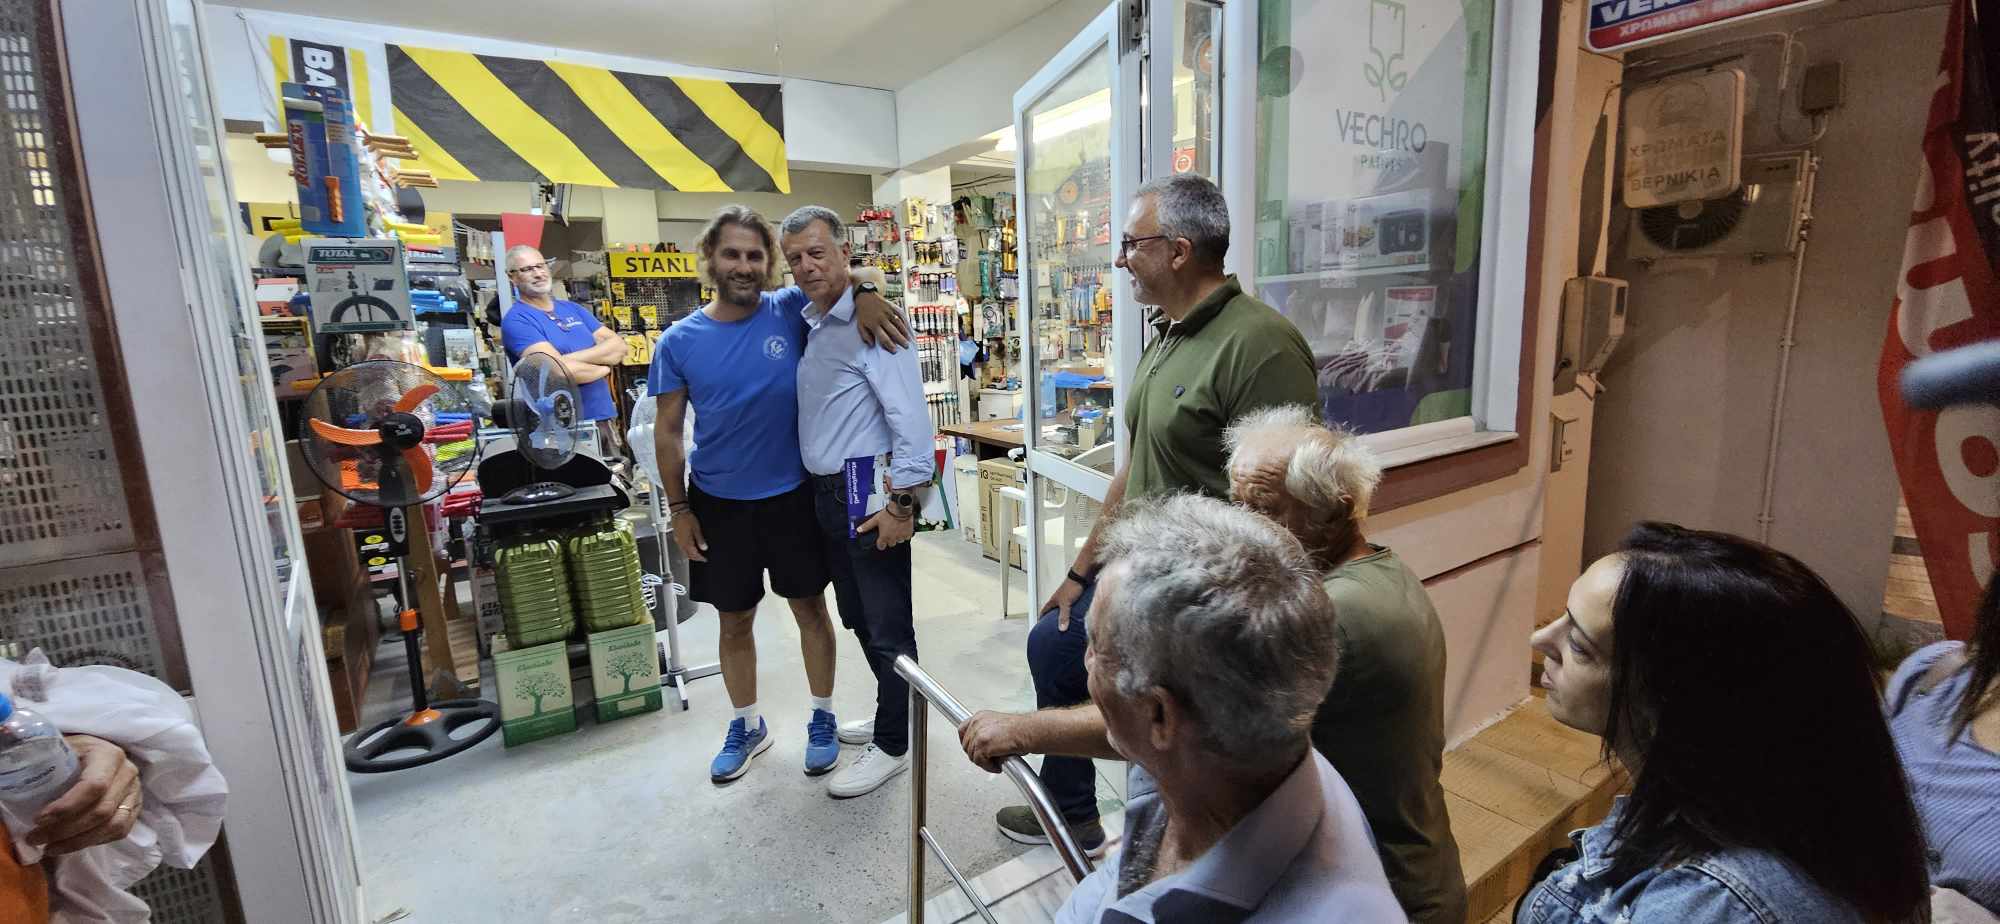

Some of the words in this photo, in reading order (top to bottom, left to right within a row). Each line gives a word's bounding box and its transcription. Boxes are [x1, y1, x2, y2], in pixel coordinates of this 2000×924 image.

[302, 46, 337, 88] BA
[1335, 108, 1427, 153] VECHRO
[1630, 166, 1721, 191] ΒΕΡΝΙΚΙΑ
[317, 249, 357, 258] TOTAL
[624, 256, 695, 273] STANL
